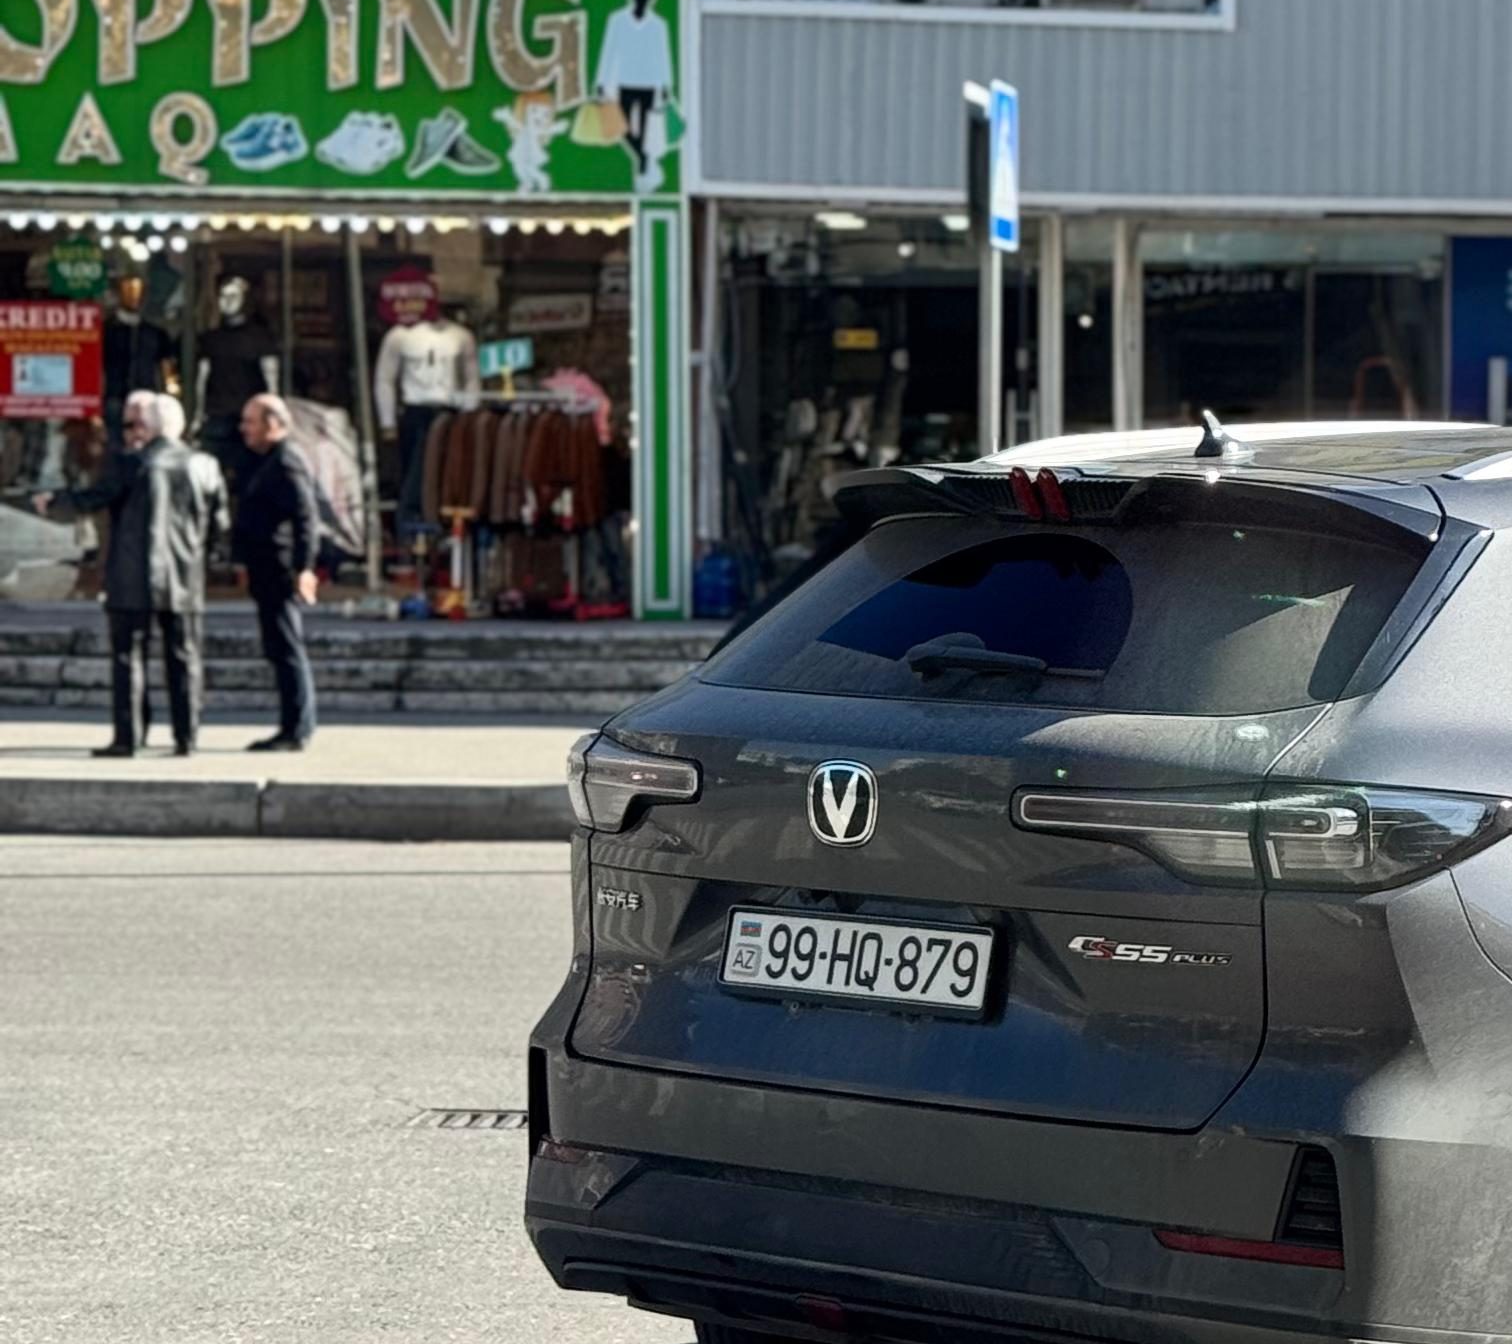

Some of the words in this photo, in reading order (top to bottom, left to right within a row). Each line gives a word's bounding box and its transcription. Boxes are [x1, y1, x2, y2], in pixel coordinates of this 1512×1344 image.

[0, 304, 98, 329] REDİT
[733, 950, 754, 969] AZ
[765, 923, 979, 997] 99-HQ-879
[1068, 936, 1172, 963] CS55
[1172, 953, 1230, 965] PLUS
